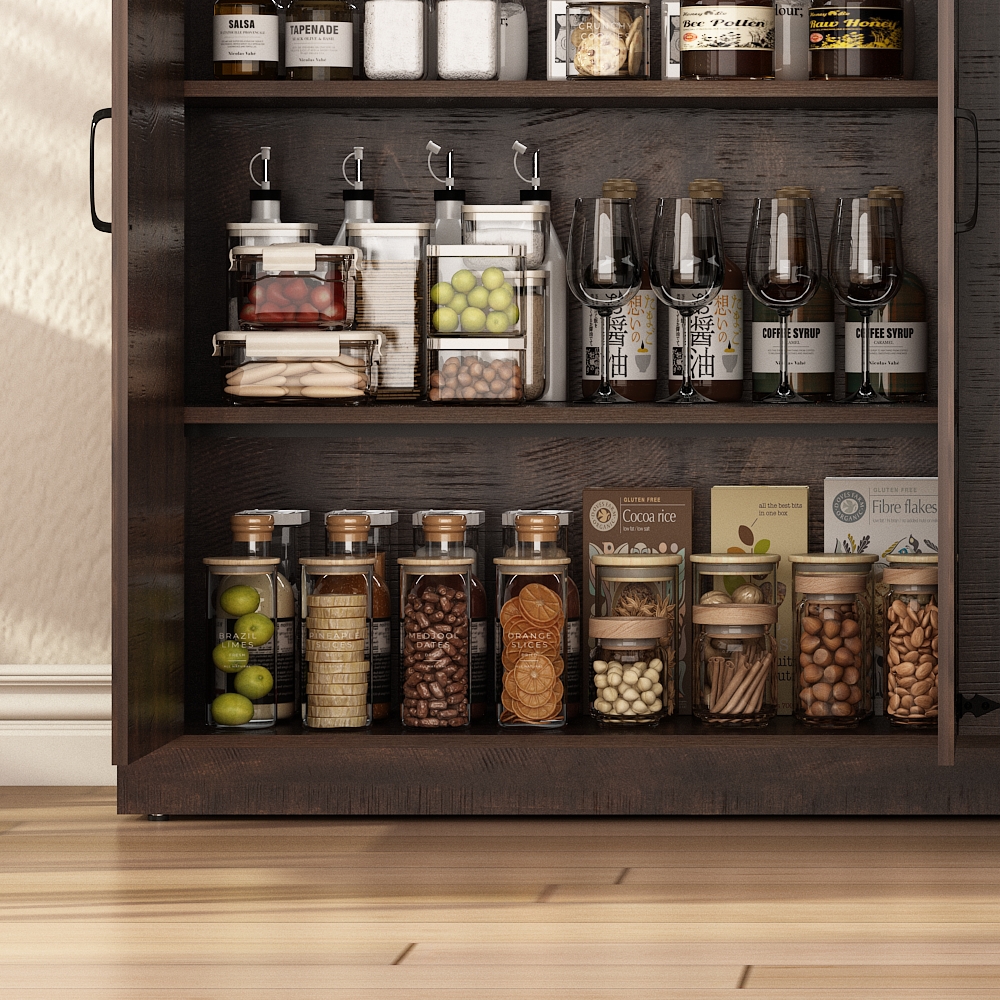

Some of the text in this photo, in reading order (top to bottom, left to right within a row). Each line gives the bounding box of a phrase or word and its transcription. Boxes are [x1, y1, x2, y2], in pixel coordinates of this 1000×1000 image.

[775, 6, 804, 18] lour;
[228, 20, 255, 28] SALSA
[682, 19, 766, 28] Bee Pollen
[810, 18, 897, 30] Raw Honey
[290, 24, 338, 34] TAPENADE
[762, 328, 821, 338] COFFE SYRUP
[886, 328, 914, 338] SYRUP
[872, 499, 938, 514] Fibre flakes
[622, 509, 676, 522] Cocoa rice
